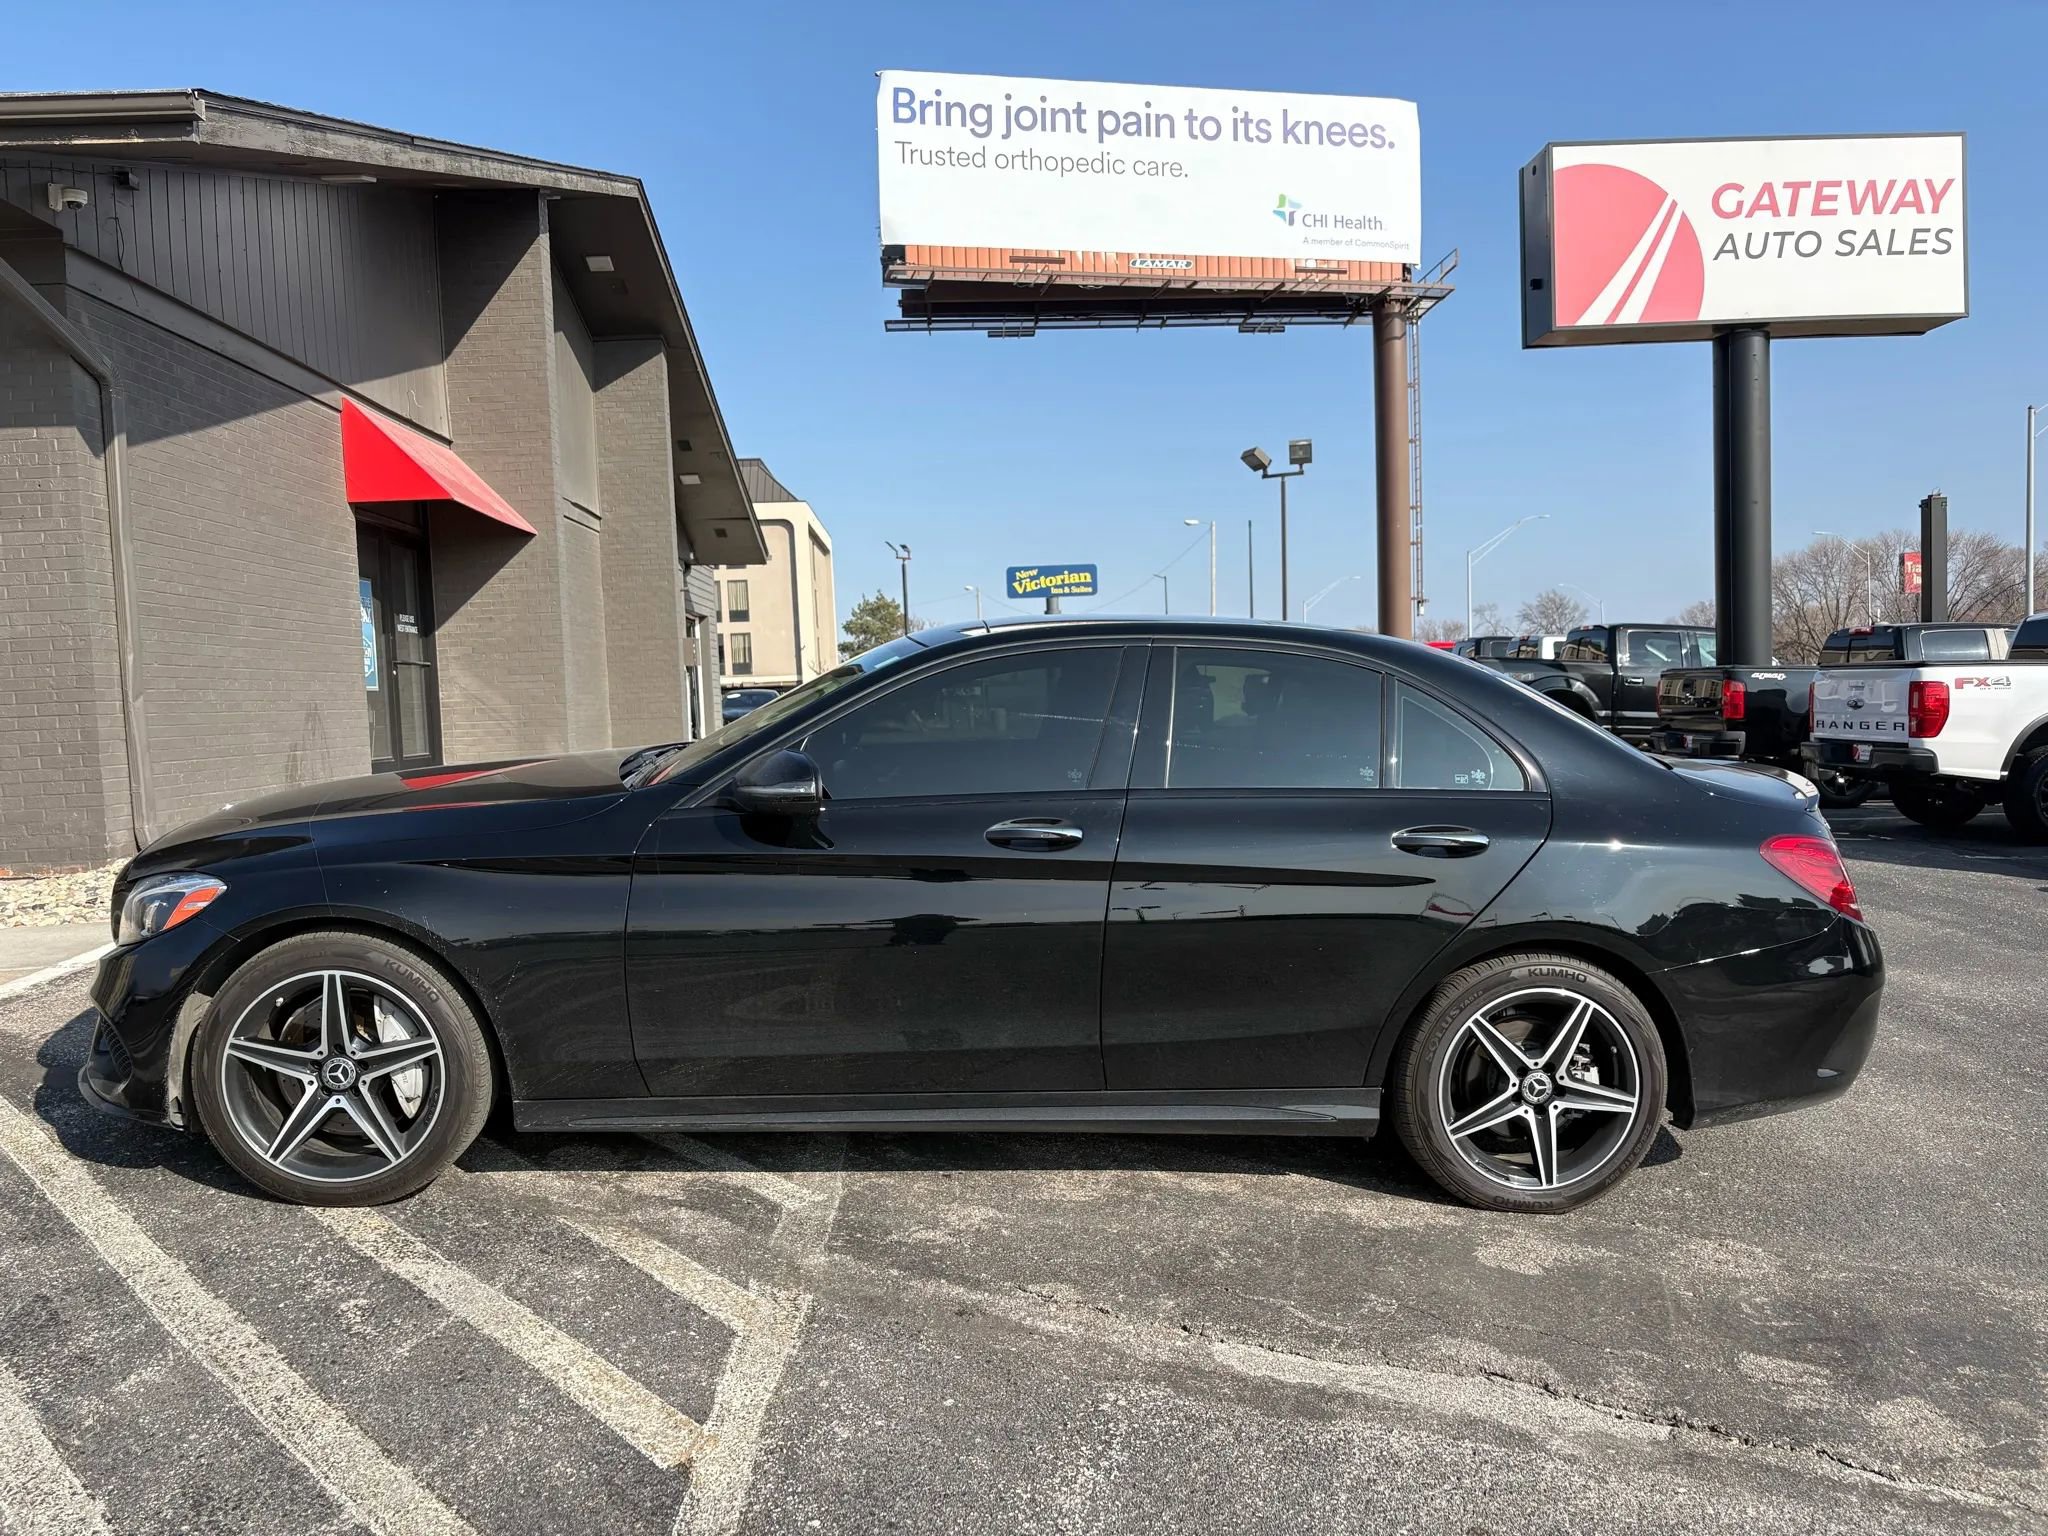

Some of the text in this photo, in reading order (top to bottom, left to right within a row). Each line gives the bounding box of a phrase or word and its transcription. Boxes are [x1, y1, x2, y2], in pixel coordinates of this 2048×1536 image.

[892, 87, 1397, 150] Bring joint pain to its knees.
[894, 141, 1189, 178] Trusted orthopedic care.
[1711, 178, 1955, 219] GATEWAY
[1302, 213, 1383, 231] CHI Health
[1302, 236, 1410, 251] A member of CommonSpirit
[1712, 227, 1953, 261] AUTO SALES
[1135, 259, 1187, 269] LAMAR
[1015, 568, 1039, 580] New
[1905, 561, 1921, 574] Tra
[1012, 570, 1092, 594] Victorian
[1954, 675, 2012, 690] FX4
[1815, 719, 1906, 732] RANGER
[385, 958, 440, 1004] KUMHO
[1527, 967, 1588, 983] KUMHO
[1425, 1006, 1461, 1063] SOLUS
[1493, 1195, 1554, 1209] KUMHO
